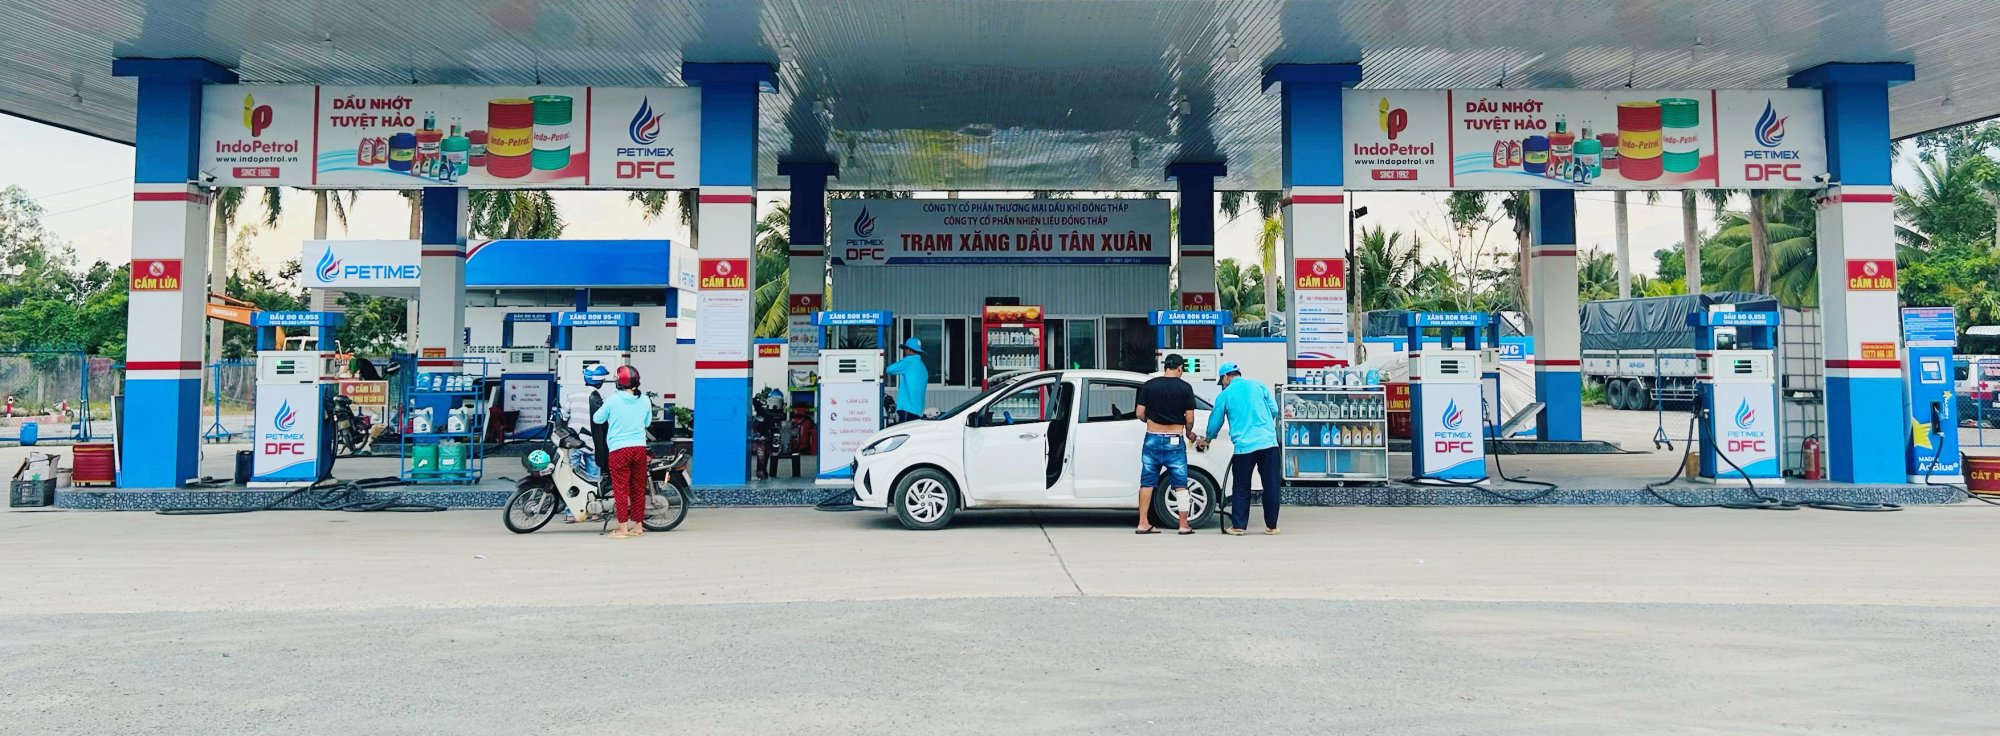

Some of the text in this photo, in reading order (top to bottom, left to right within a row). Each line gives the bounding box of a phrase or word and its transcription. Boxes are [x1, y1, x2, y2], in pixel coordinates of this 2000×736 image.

[334, 94, 412, 110] DẦU NHỚT
[1466, 98, 1543, 113] DẦU NHỚT
[331, 112, 415, 130] TUYỆT HẢO
[1464, 116, 1547, 133] TUYỆT HẢO
[216, 140, 298, 152] IndoPetrol
[616, 148, 674, 157] PETIMEX
[1354, 143, 1434, 156] IndoPetrol
[1744, 150, 1799, 159] PETIMEX
[616, 162, 675, 179] DFC
[1745, 164, 1801, 181] DFC
[923, 203, 945, 212] CÔNG
[947, 204, 958, 212] TY
[996, 203, 1030, 212] THƯƠNG
[1032, 204, 1046, 214] MẠI
[1107, 202, 1128, 212] THÁP
[944, 216, 966, 225] CÔNG
[968, 217, 978, 225] TY
[1016, 216, 1040, 225] NHIÊN
[1087, 215, 1108, 225] THÁP
[901, 228, 1152, 255] TRẠM XĂNG DẦU TÂN XUÂN
[846, 248, 884, 260] DFC
[134, 275, 178, 288] CẤM LỬA
[702, 275, 724, 287] CẤM
[727, 274, 745, 287] LỬA
[1299, 274, 1341, 287] CẤM LỬA
[1850, 275, 1892, 288] CẤM LỬA
[1500, 344, 1519, 354] WC
[265, 443, 304, 454] DFC
[1435, 441, 1473, 453] DFC
[1728, 441, 1766, 452] DFC
